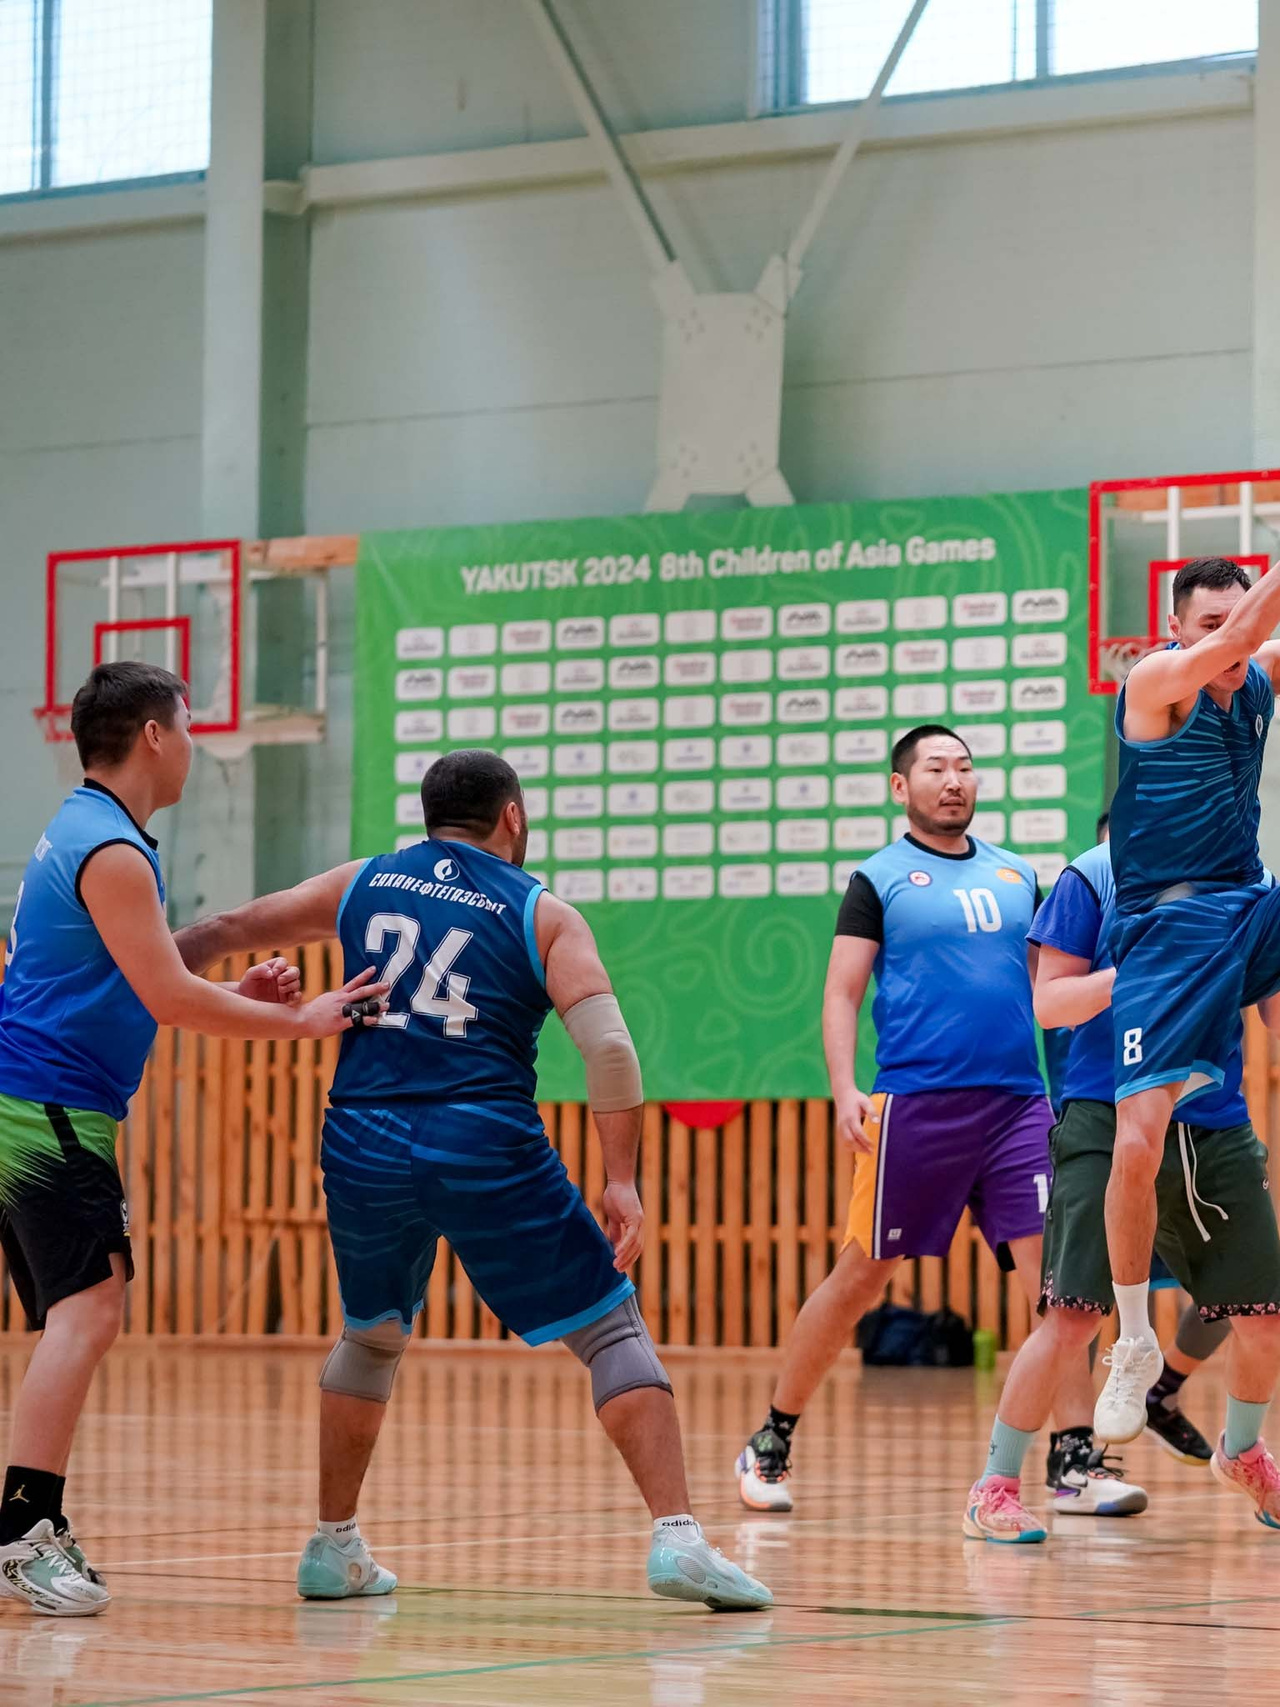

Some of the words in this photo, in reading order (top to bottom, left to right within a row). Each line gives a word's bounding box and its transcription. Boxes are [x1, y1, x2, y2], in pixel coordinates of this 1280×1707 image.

[460, 558, 579, 595] YAKUTSK
[582, 553, 653, 587] 2024
[659, 550, 705, 582] 8th
[708, 545, 812, 579] Children
[815, 540, 844, 572] of
[846, 538, 902, 570] Asia
[905, 535, 997, 566] Games
[952, 887, 1003, 934] 10
[365, 912, 479, 1039] 24
[1123, 1027, 1143, 1067] 8
[1033, 1173, 1053, 1213] 1
